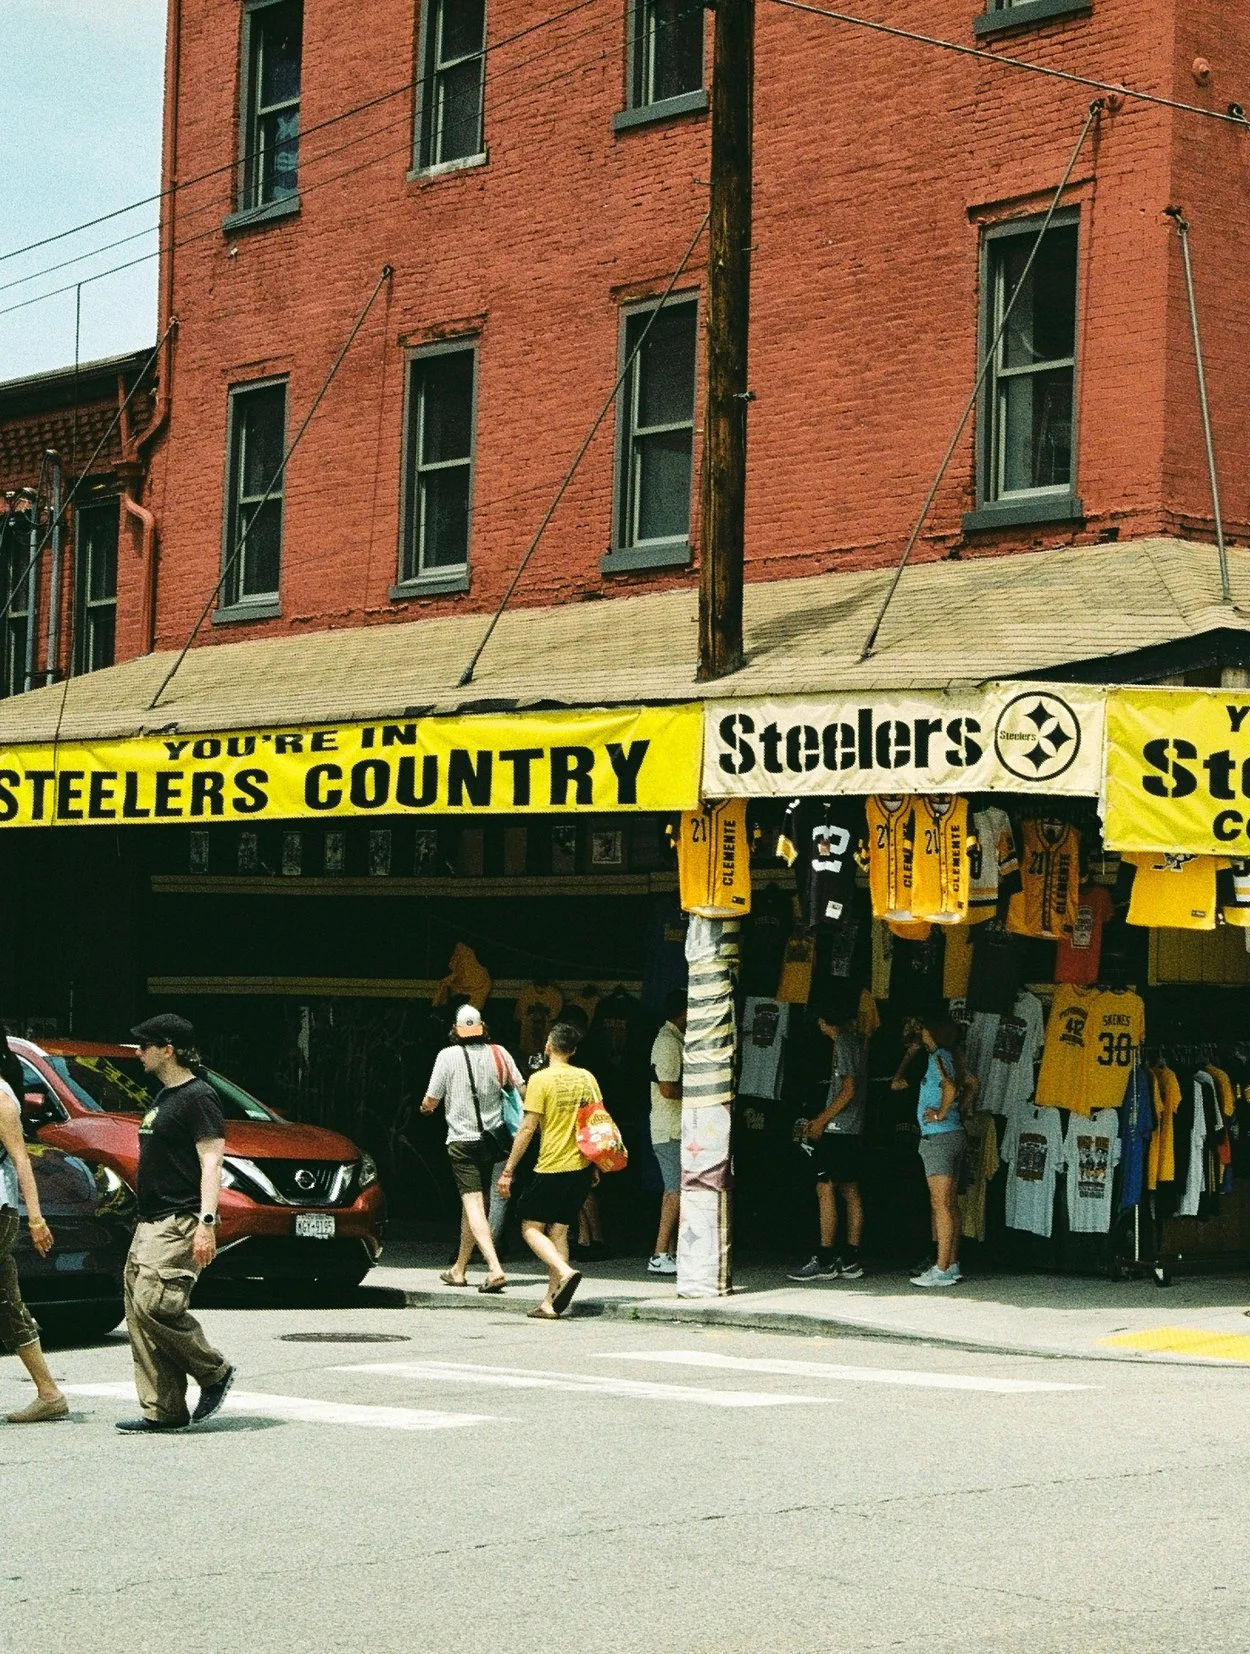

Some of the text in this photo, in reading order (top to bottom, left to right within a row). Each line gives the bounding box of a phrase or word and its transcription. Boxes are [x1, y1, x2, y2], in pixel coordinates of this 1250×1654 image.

[164, 724, 419, 761] YOU'RE IN
[718, 708, 983, 775] Steelers
[1000, 730, 1037, 741] Steelers
[0, 739, 651, 822] STEELERS COUNTRY
[690, 816, 707, 843] 21
[925, 828, 940, 855] 21
[722, 819, 737, 887] CLEMENTE
[950, 824, 961, 893] CLEMENTE
[1102, 1014, 1131, 1026] SKENES
